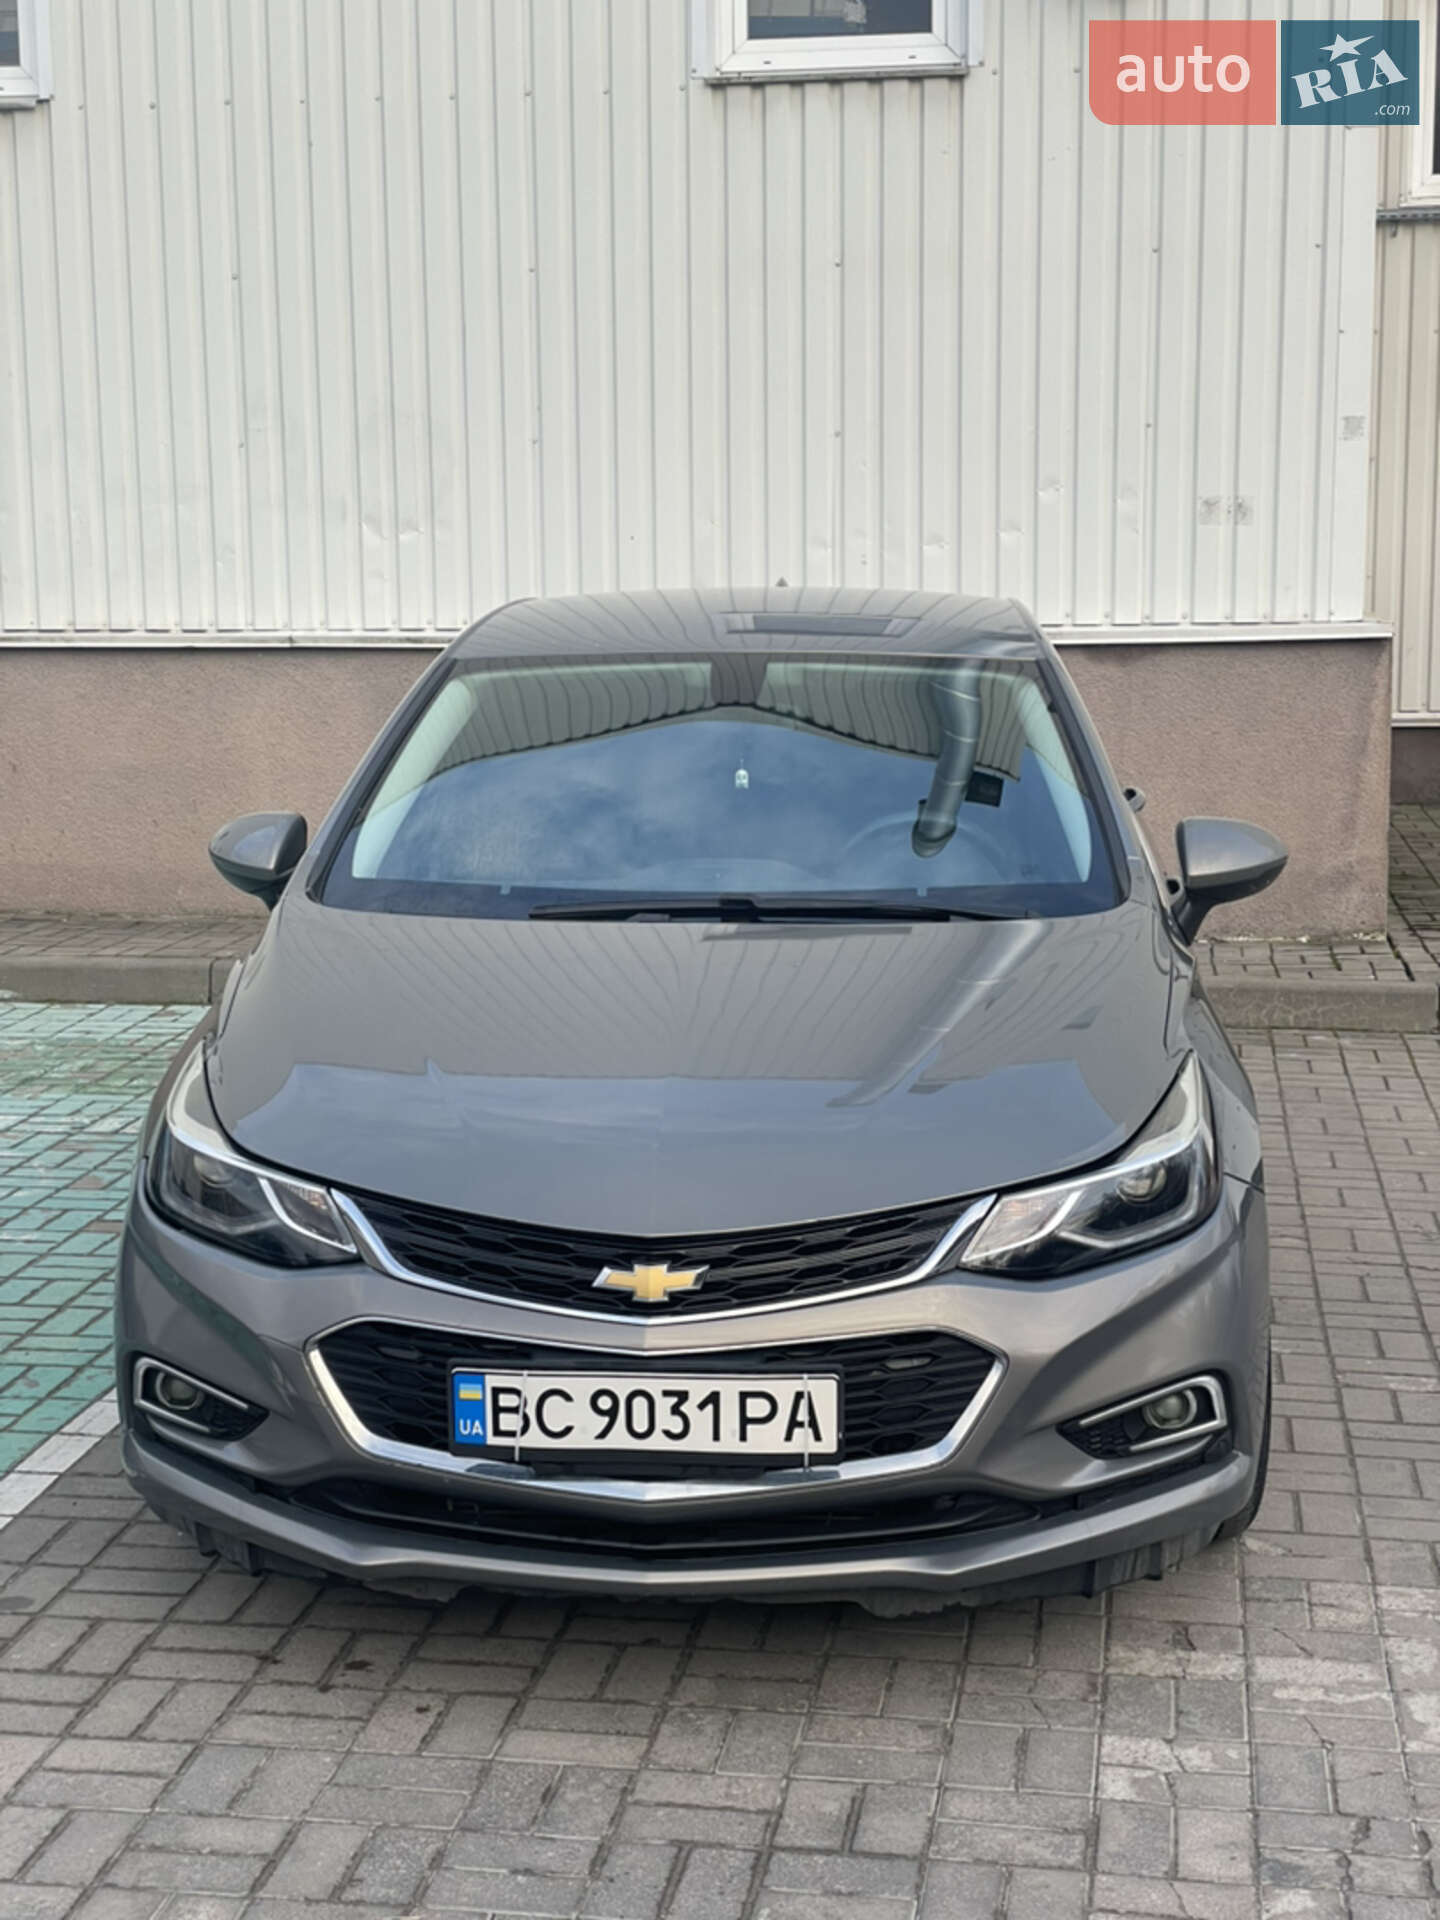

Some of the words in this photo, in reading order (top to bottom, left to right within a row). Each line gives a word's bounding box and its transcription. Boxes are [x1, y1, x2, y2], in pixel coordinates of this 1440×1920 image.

[459, 1418, 484, 1435] UA
[491, 1386, 575, 1440] BC
[589, 1388, 721, 1442] 9031
[738, 1390, 823, 1442] PA
